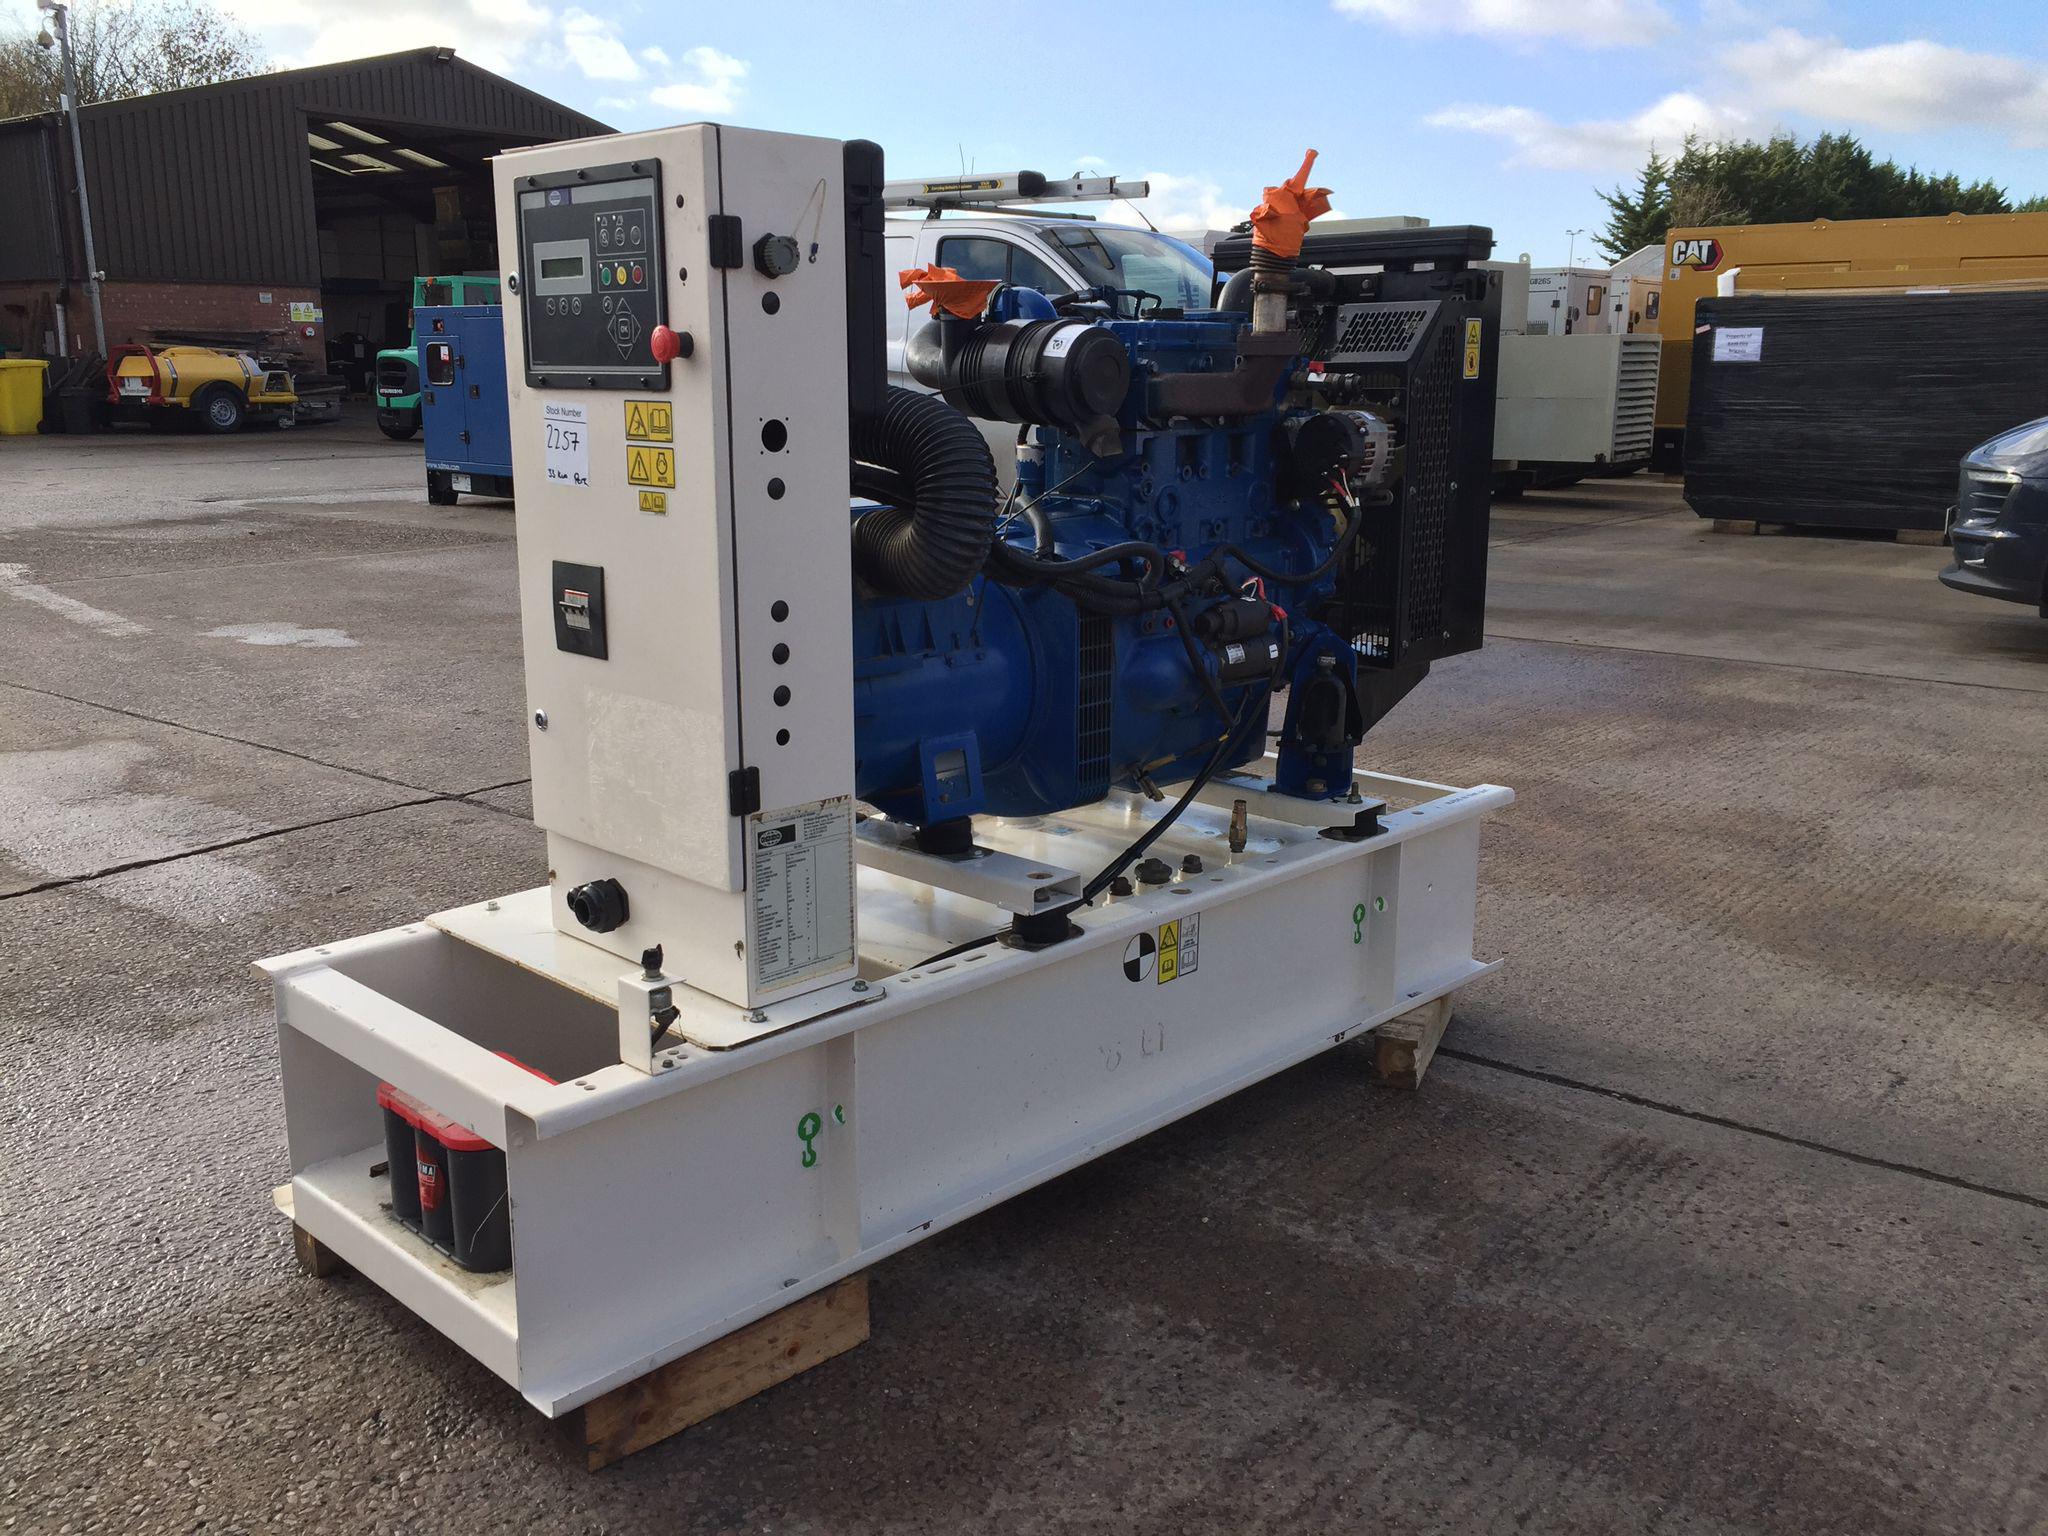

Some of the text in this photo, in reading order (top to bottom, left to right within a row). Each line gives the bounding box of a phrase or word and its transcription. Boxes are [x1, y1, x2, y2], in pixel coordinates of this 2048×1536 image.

[1672, 240, 1713, 266] CAT
[620, 325, 629, 333] OK
[545, 405, 582, 418] Stock Number
[546, 423, 580, 452] 2257
